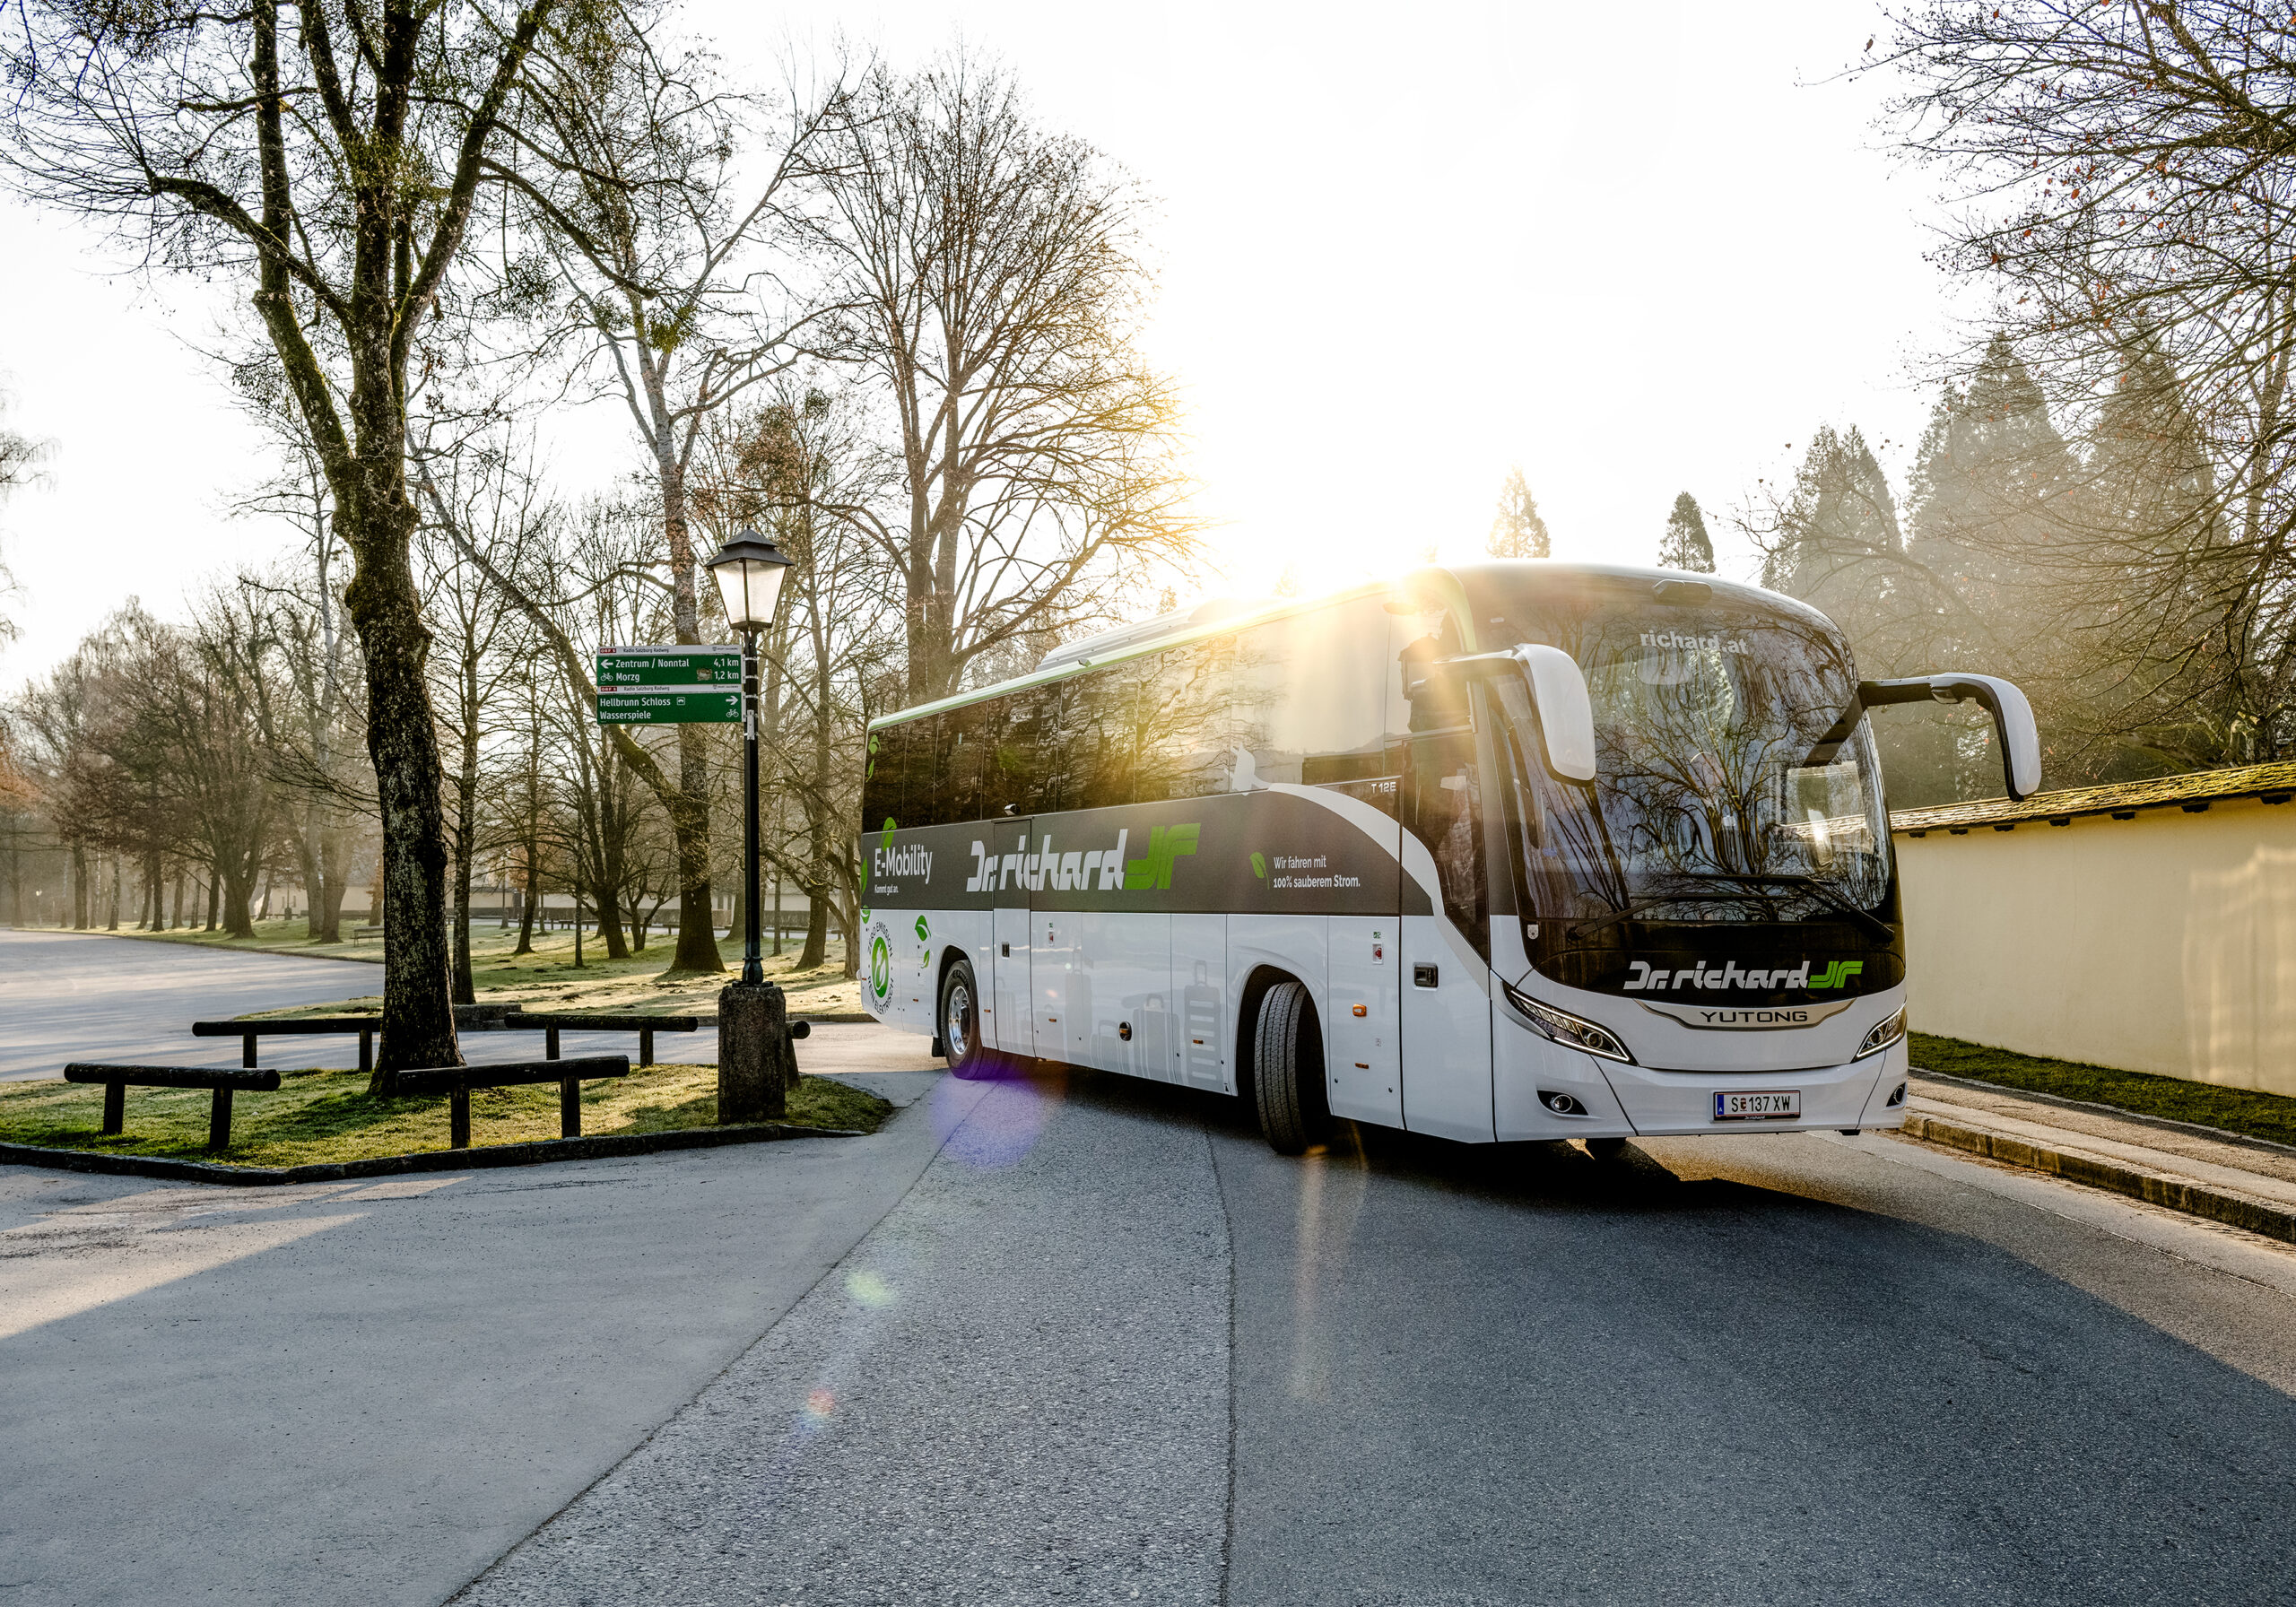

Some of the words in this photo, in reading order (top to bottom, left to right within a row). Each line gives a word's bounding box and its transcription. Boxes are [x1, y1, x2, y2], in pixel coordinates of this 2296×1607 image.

[1639, 630, 1748, 655] richard.at
[615, 659, 649, 668] Zentrum
[657, 658, 690, 668] Nonntal
[713, 658, 725, 668] 4,1
[727, 658, 739, 667] km
[615, 673, 640, 682] Morzg
[714, 671, 726, 681] 1,2
[727, 671, 739, 680] km
[600, 698, 639, 707] Hellbrunn
[641, 697, 671, 706] Schloss
[600, 710, 651, 721] Wasserspiele
[874, 844, 933, 885] E-Mobility
[1274, 856, 1287, 869] Wir
[1288, 856, 1311, 869] fahren
[1313, 855, 1327, 868] mit
[1274, 875, 1292, 888] 100%
[1293, 875, 1332, 888] sauberem
[1334, 874, 1361, 888] Strom.
[1700, 1011, 1808, 1023] YUTONG
[1731, 1097, 1739, 1113] S
[1748, 1096, 1770, 1112] 137
[1773, 1095, 1790, 1112] XW
